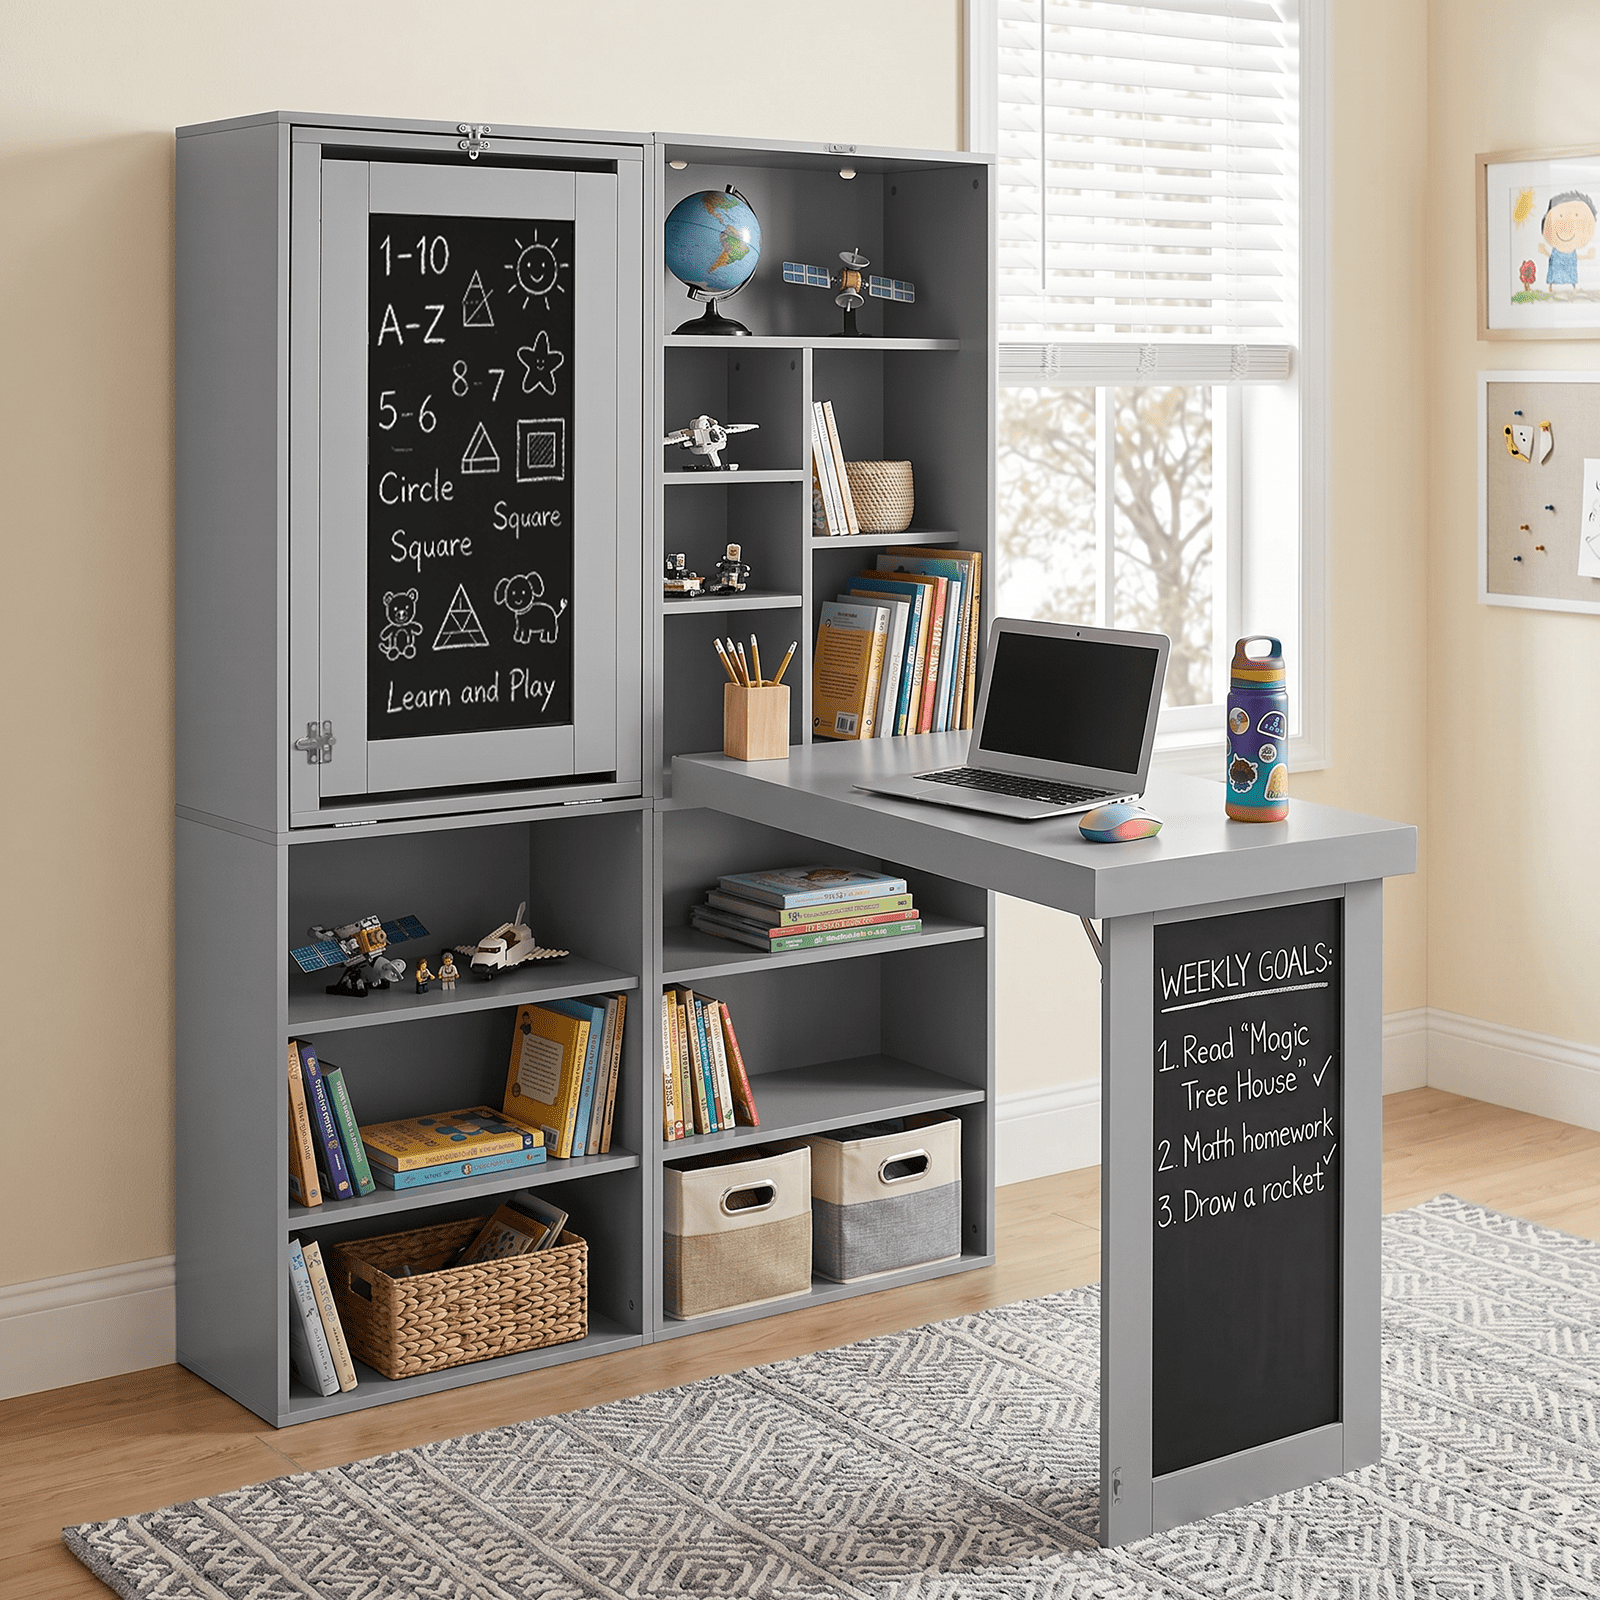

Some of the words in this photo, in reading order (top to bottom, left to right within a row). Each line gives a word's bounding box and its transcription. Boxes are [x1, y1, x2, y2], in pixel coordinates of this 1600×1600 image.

[380, 236, 449, 275] 1-10
[378, 304, 445, 345] A-Z
[379, 469, 453, 504] Circle
[494, 501, 561, 539] Square
[391, 530, 472, 572] Square
[387, 681, 450, 713] Learn
[461, 671, 498, 703] and
[510, 668, 555, 711] Play
[1161, 953, 1250, 1000] WEEKLY
[1259, 943, 1333, 981] GOALS:
[1158, 1040, 1179, 1072] 1.
[1184, 1027, 1233, 1067] Read
[1181, 1080, 1228, 1110] Tree
[1158, 1140, 1178, 1171] 2.
[1184, 1127, 1234, 1167] Math
[1243, 1108, 1334, 1153] homework
[1159, 1195, 1176, 1227] 3.
[1244, 1188, 1256, 1208] a
[1263, 1162, 1325, 1203] rocket
